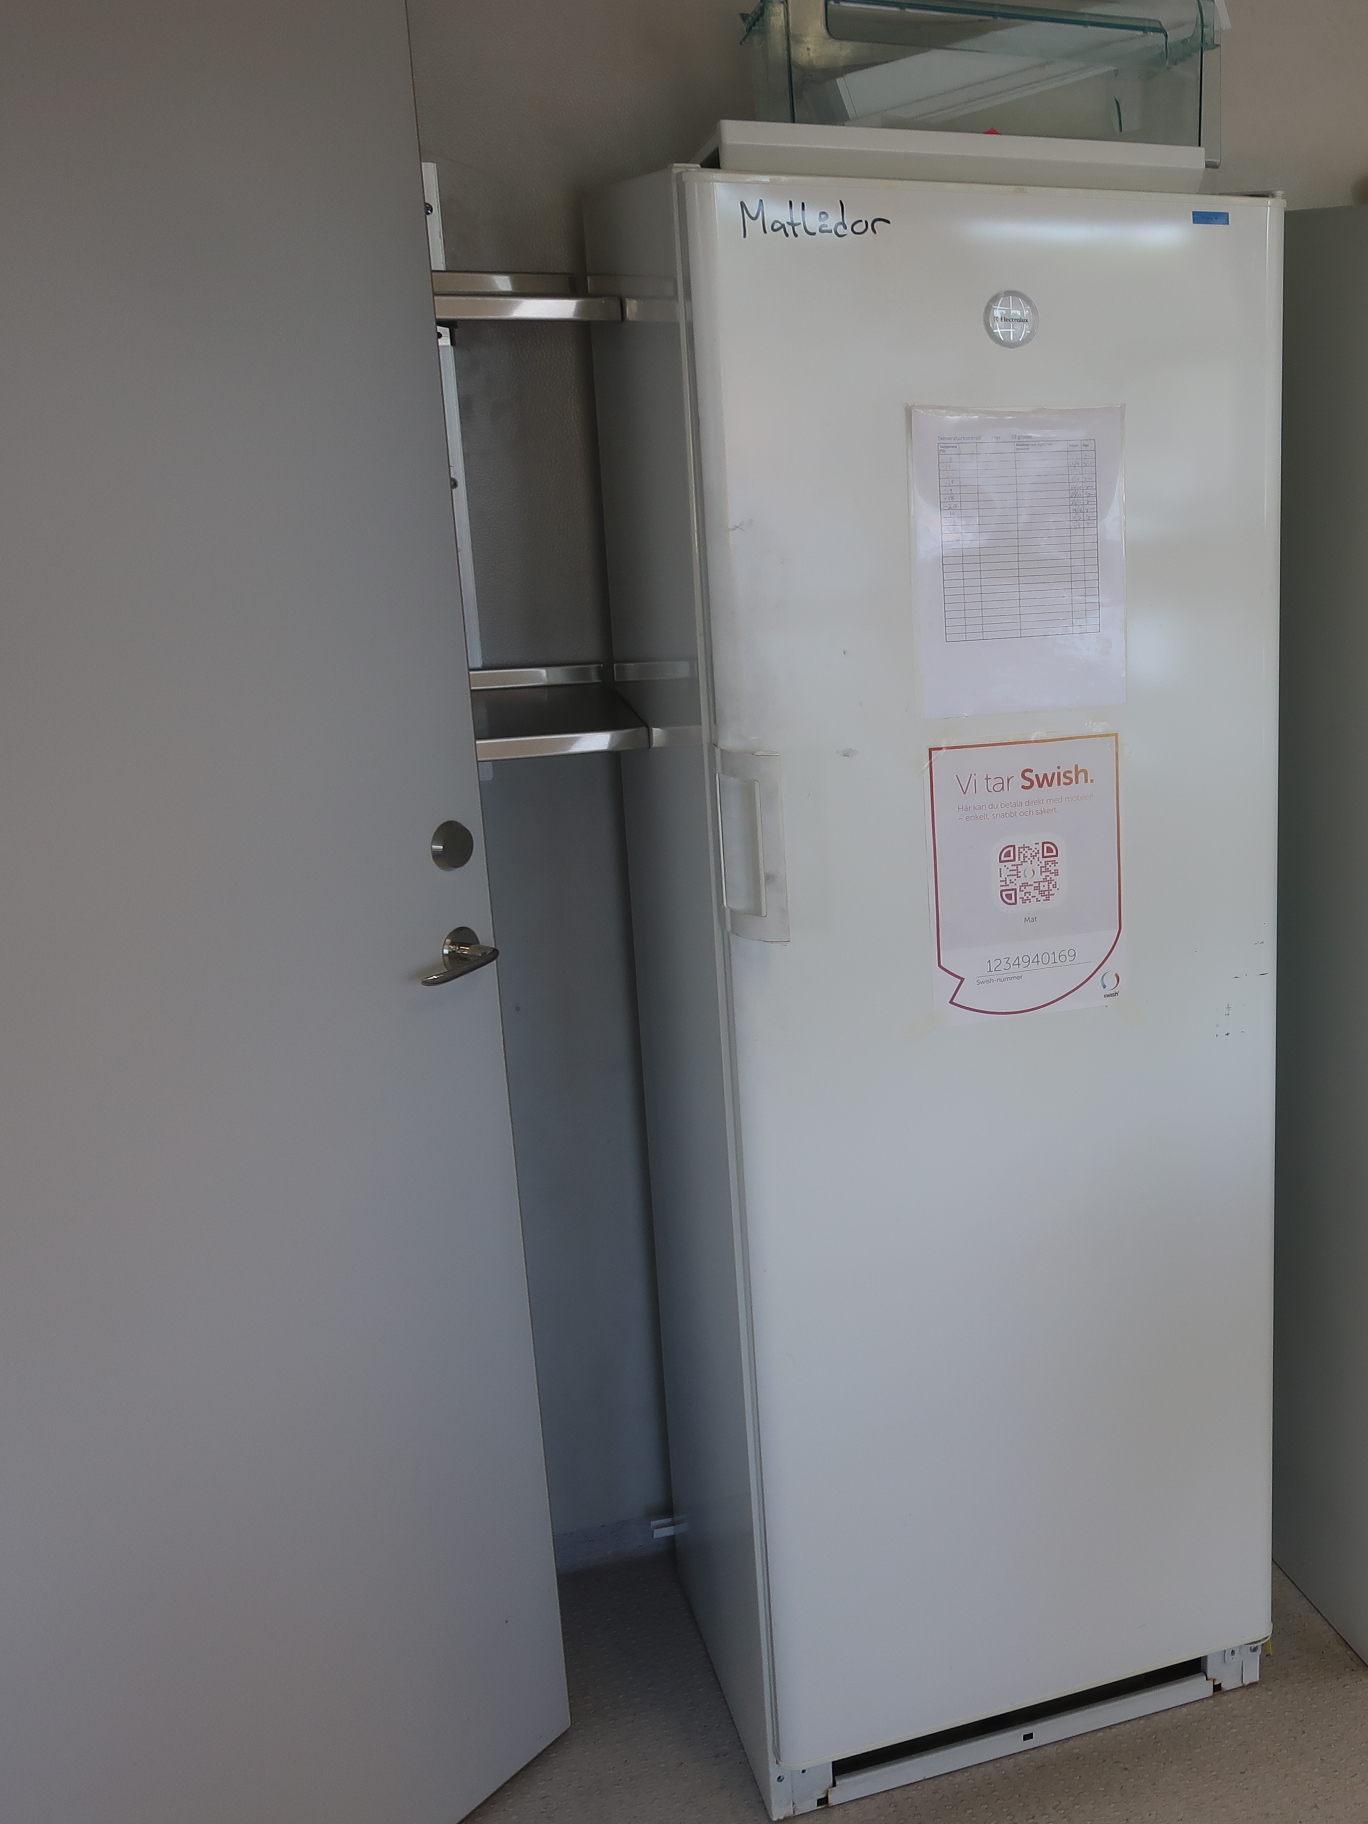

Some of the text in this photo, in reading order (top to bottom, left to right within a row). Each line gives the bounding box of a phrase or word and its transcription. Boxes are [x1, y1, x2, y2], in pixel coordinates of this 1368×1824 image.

[740, 199, 891, 238] Matlådor
[955, 763, 1094, 795] Vi tar Swish.
[973, 803, 987, 811] kan
[988, 802, 998, 810] du
[1000, 800, 1023, 809] betala
[1024, 798, 1045, 806] direkt
[1046, 796, 1063, 804] med
[992, 810, 1017, 819] snabbt
[1019, 809, 1034, 817] och
[986, 948, 1077, 973] 1234940169
[976, 974, 1023, 986] Swish-nummer
